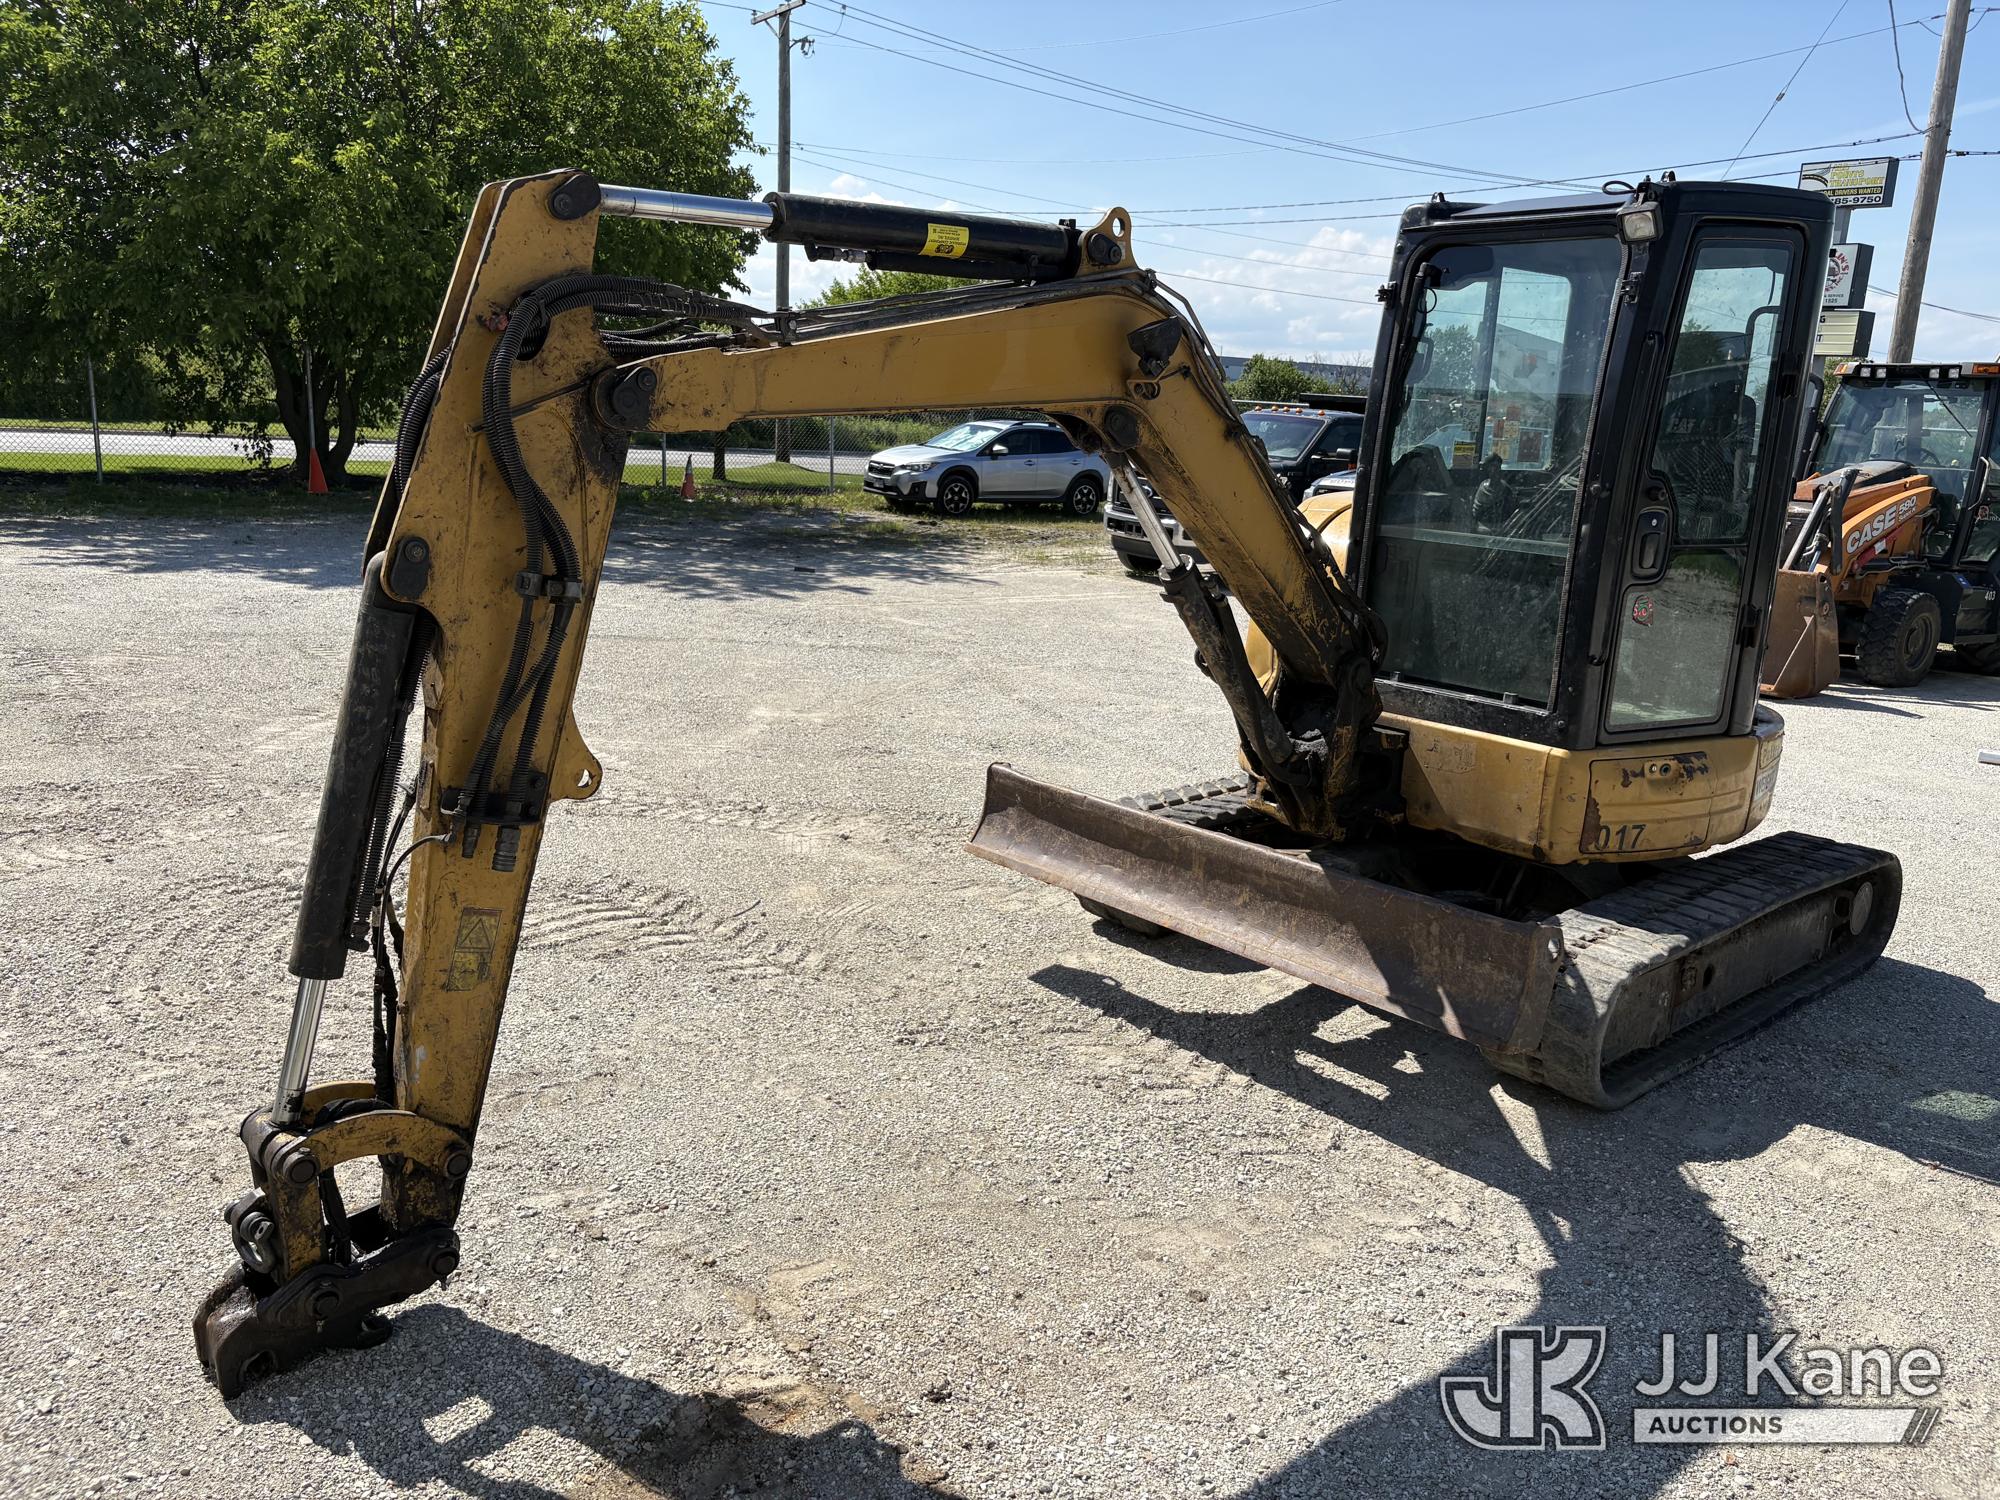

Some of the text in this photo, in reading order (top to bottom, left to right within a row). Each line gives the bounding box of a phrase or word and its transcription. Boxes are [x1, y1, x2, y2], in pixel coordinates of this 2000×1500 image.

[1834, 188, 1858, 196] DRIVERS
[1858, 187, 1882, 195] WANTED
[1831, 195, 1882, 205] 85-9750
[1847, 495, 1917, 554] CASE 580
[1984, 590, 1996, 601] 403
